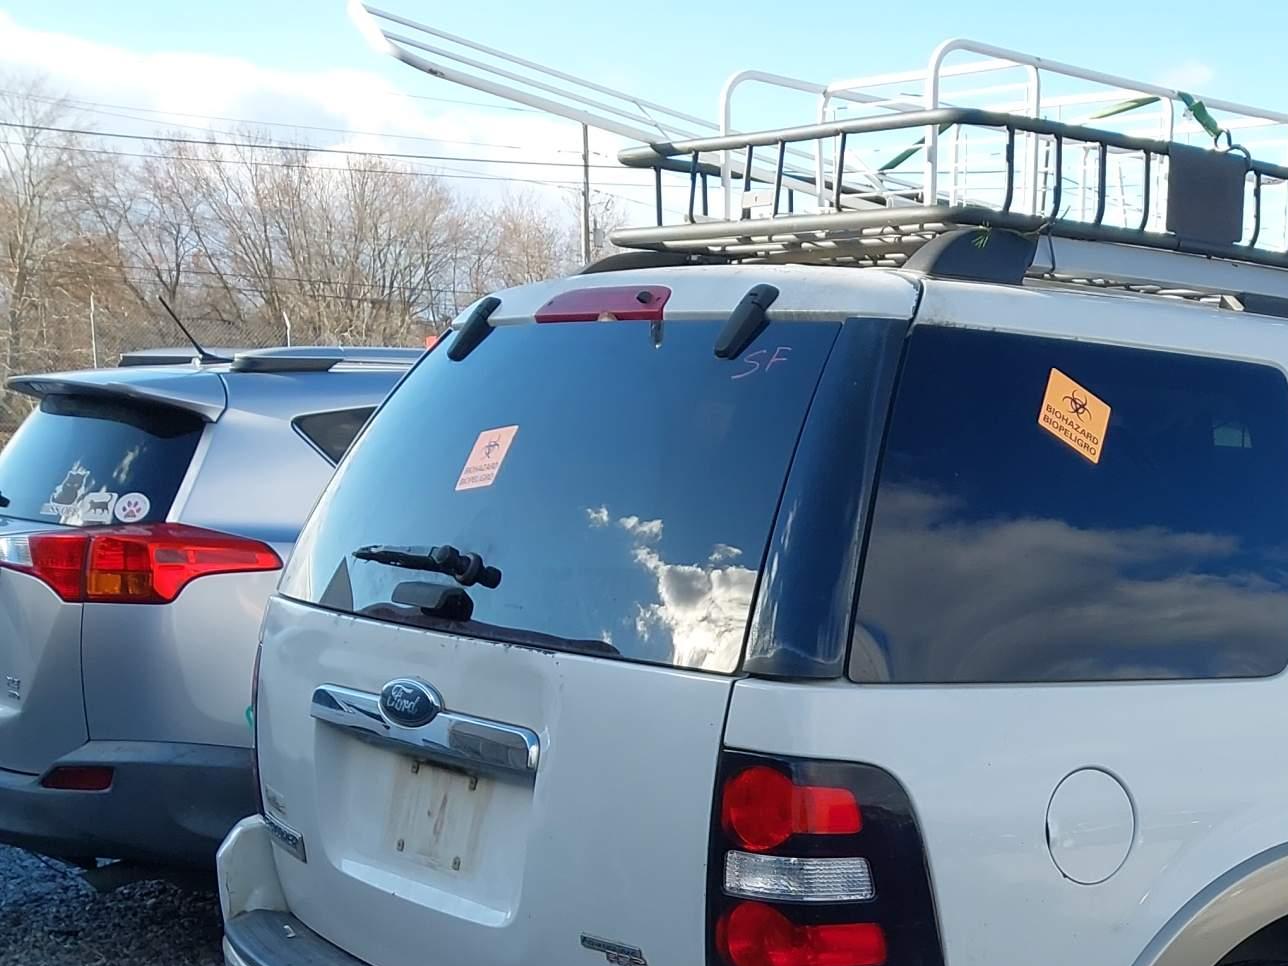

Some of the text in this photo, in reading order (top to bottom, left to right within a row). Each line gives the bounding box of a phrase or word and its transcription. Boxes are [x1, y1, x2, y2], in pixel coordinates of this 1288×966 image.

[731, 346, 792, 380] SF
[1043, 414, 1097, 456] BIOPELIGRO
[1046, 404, 1099, 446] BIOHAZARD
[386, 684, 421, 715] Ford
